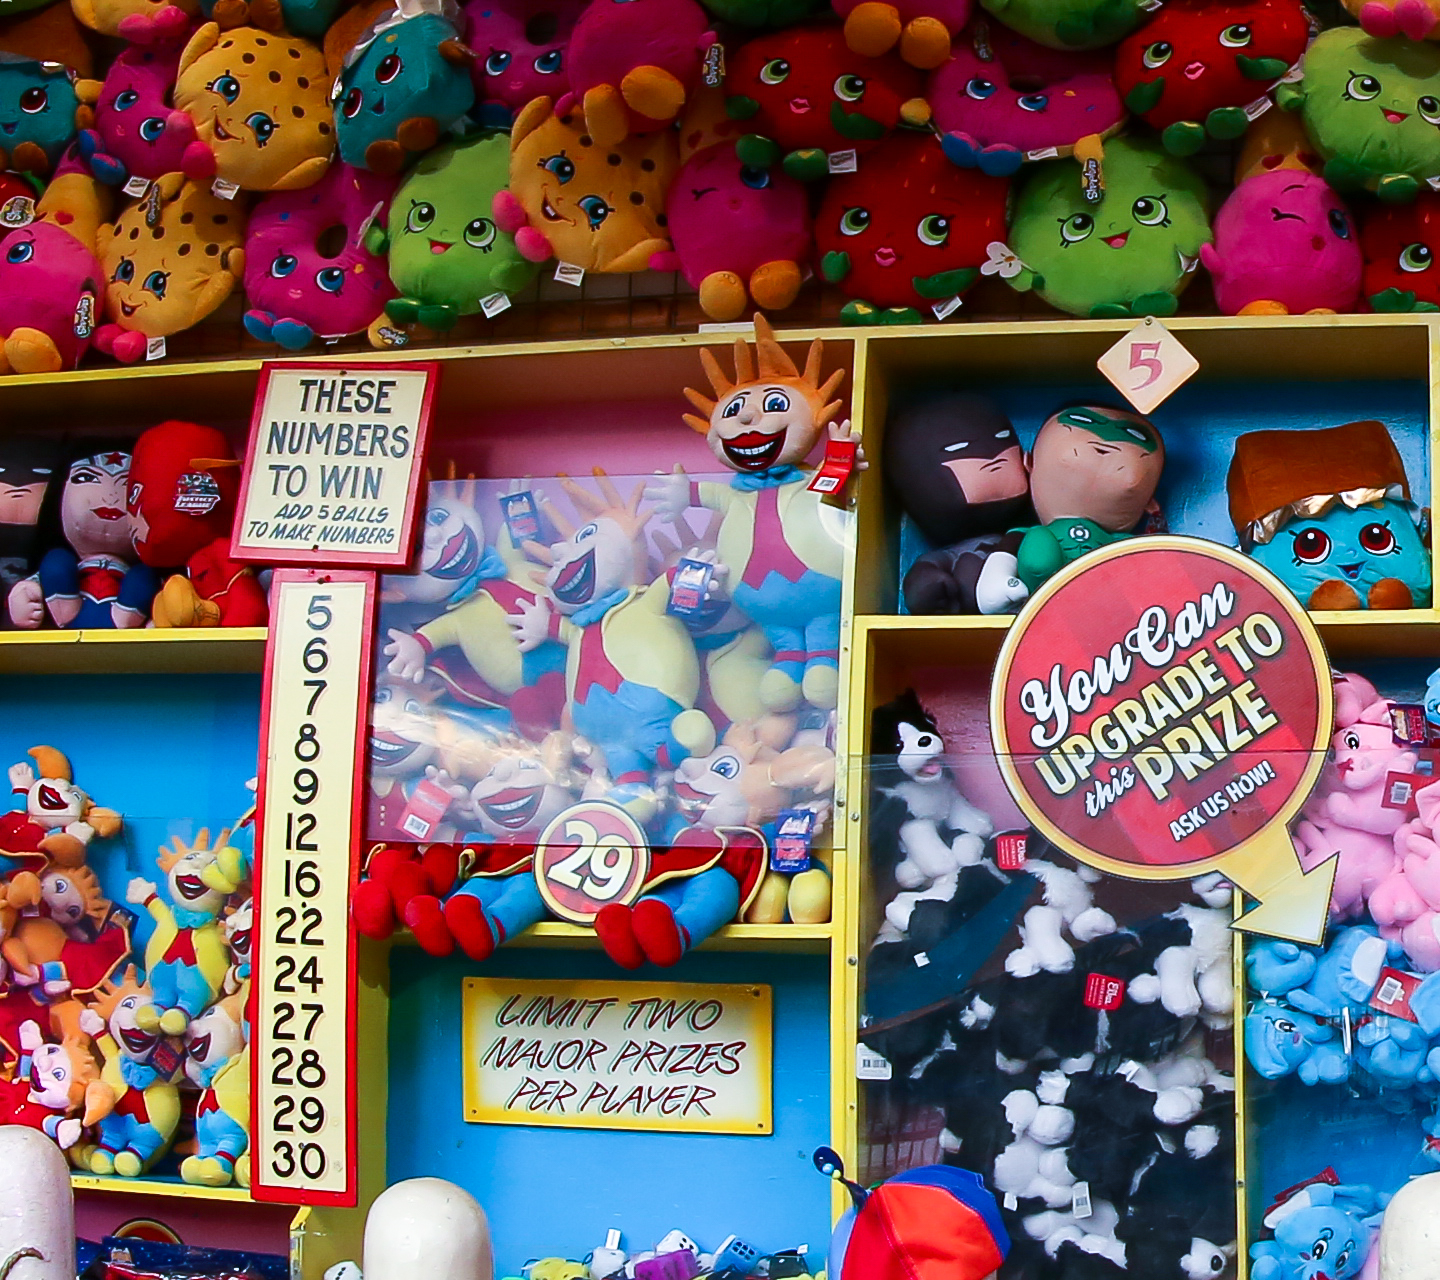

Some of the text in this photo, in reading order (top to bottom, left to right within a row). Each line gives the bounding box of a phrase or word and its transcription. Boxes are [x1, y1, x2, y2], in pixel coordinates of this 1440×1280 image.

[1128, 342, 1163, 388] 5
[300, 377, 397, 414] THESE
[265, 419, 410, 459] NUMBERS
[268, 463, 384, 499] TO WIN
[247, 520, 395, 545] TO MAKE NUMBERS
[274, 502, 389, 524] ADD 5 BALLS
[305, 594, 332, 631] 5
[301, 637, 329, 674] 6
[1021, 582, 1235, 748] You Can
[301, 680, 328, 716] 7
[1033, 612, 1284, 795] UPGRADE TO
[293, 725, 320, 762] 8
[1085, 679, 1279, 818] this PRIZE
[292, 768, 318, 805] 9
[1168, 759, 1278, 843] ASK US HOW!
[284, 812, 318, 851] 12
[283, 857, 321, 900] 16
[547, 819, 634, 901] 29
[275, 907, 323, 947] 22
[274, 955, 323, 995] 24
[273, 1003, 322, 1043] 27
[496, 993, 723, 1032] LIMIT TWO
[271, 1048, 326, 1090] 28
[481, 1036, 747, 1076] MAJOR PRIZES
[273, 1095, 325, 1135] 29
[505, 1077, 716, 1118] PER PLAYER
[271, 1140, 326, 1180] 30
